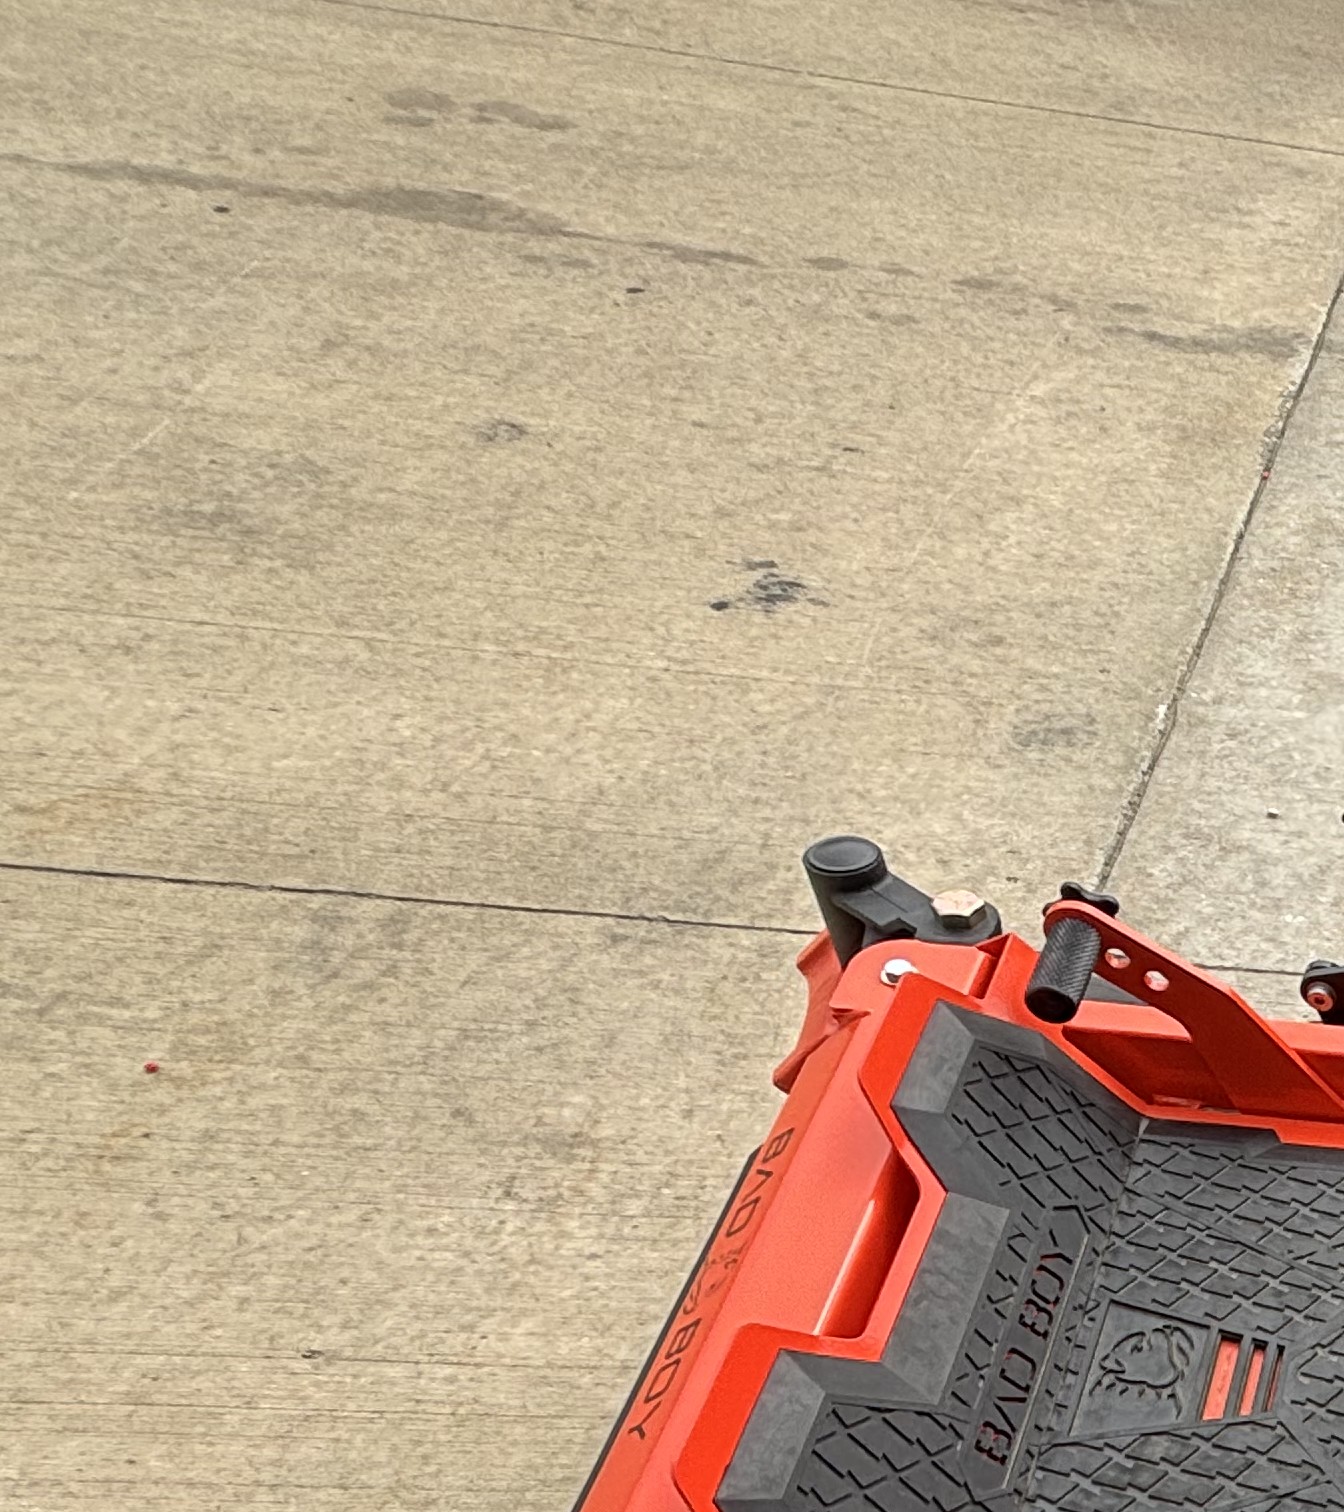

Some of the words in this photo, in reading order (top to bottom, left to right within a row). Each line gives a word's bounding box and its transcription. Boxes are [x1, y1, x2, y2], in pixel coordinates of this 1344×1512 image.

[725, 1128, 795, 1238] BAD
[628, 1318, 702, 1440] BOY
[974, 1347, 1038, 1467] BAD
[1018, 1229, 1074, 1341] BOY
